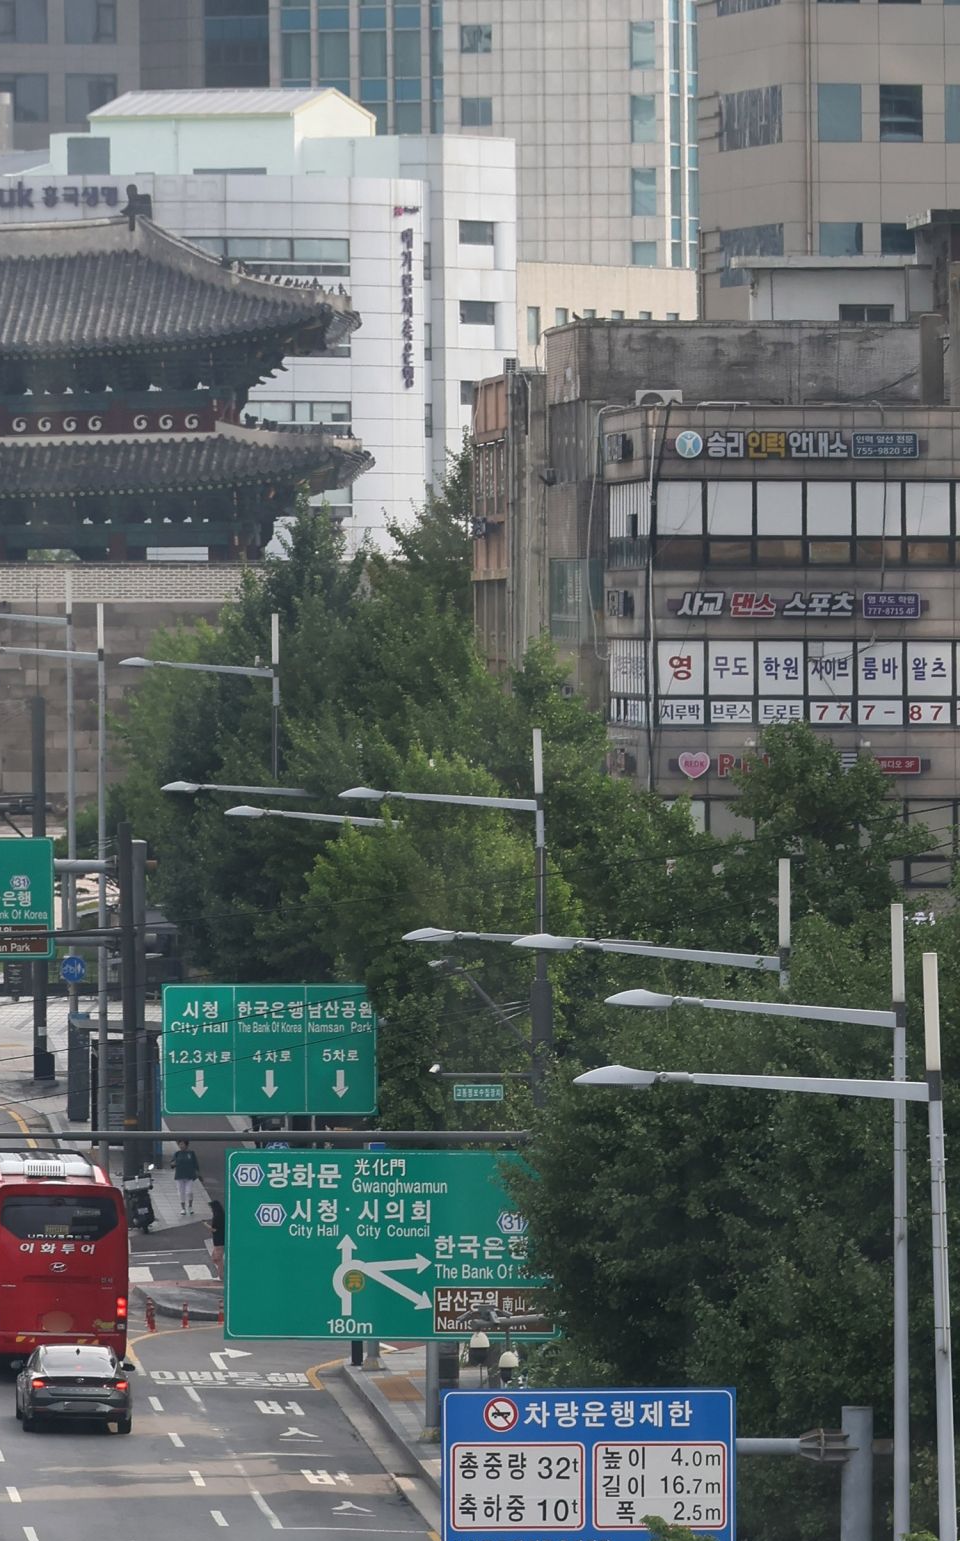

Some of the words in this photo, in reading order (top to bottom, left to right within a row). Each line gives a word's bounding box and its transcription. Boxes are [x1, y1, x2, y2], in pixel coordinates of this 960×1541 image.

[707, 431, 744, 457] 승리
[747, 431, 786, 458] 인력
[789, 432, 849, 458] 안내소
[677, 592, 724, 616] 사교
[730, 591, 777, 618] 댄스
[782, 592, 855, 617] 스포츠
[669, 655, 692, 681] 영
[712, 656, 749, 679] 무도
[763, 656, 800, 681] 학원
[811, 656, 850, 681] 자이브
[861, 656, 898, 681] 룸바
[911, 656, 947, 681] 왈츠
[660, 703, 701, 720] 지루박
[712, 704, 752, 720] 브루스
[763, 704, 801, 719] 트로트
[12, 910, 22, 920] Of
[23, 910, 48, 920] Korea
[10, 942, 31, 952] Park
[182, 1001, 219, 1019] 시청
[237, 1001, 303, 1019] 한국은행
[307, 1001, 373, 1019] 남산공원
[171, 1022, 198, 1036] City
[202, 1022, 229, 1034] Hall
[238, 1022, 252, 1033] The
[252, 1022, 270, 1033] Bank
[271, 1022, 280, 1033] Of
[281, 1022, 302, 1033] Korea
[308, 1022, 345, 1033] Namsan
[350, 1022, 373, 1033] Park
[322, 1049, 359, 1062] 5차로
[239, 1167, 259, 1183] 50
[266, 1162, 342, 1189] 광화문
[353, 1158, 406, 1177] 光化門
[352, 1178, 448, 1197] Gwanghwamun
[262, 1207, 280, 1223] 60
[290, 1199, 339, 1223] 시청
[358, 1199, 432, 1223] 시의회
[502, 1214, 523, 1230] 31
[289, 1224, 313, 1239] City
[316, 1224, 339, 1237] Hall
[356, 1224, 381, 1239] City
[387, 1224, 430, 1238] Council
[20, 1242, 95, 1255] 이화투어
[435, 1264, 458, 1280] The
[461, 1264, 494, 1280] Bank
[496, 1264, 513, 1280] Of
[327, 1319, 373, 1334] 180m
[523, 1400, 693, 1428] 차량운행제한
[459, 1452, 527, 1480] 총중량
[602, 1447, 646, 1470] 높이
[670, 1447, 722, 1467] 4.0m
[602, 1475, 646, 1498] 길이
[660, 1475, 722, 1495] 16.7m
[458, 1493, 526, 1522] 축하중
[616, 1500, 636, 1524] 폭
[673, 1501, 722, 1521] 2.5m
